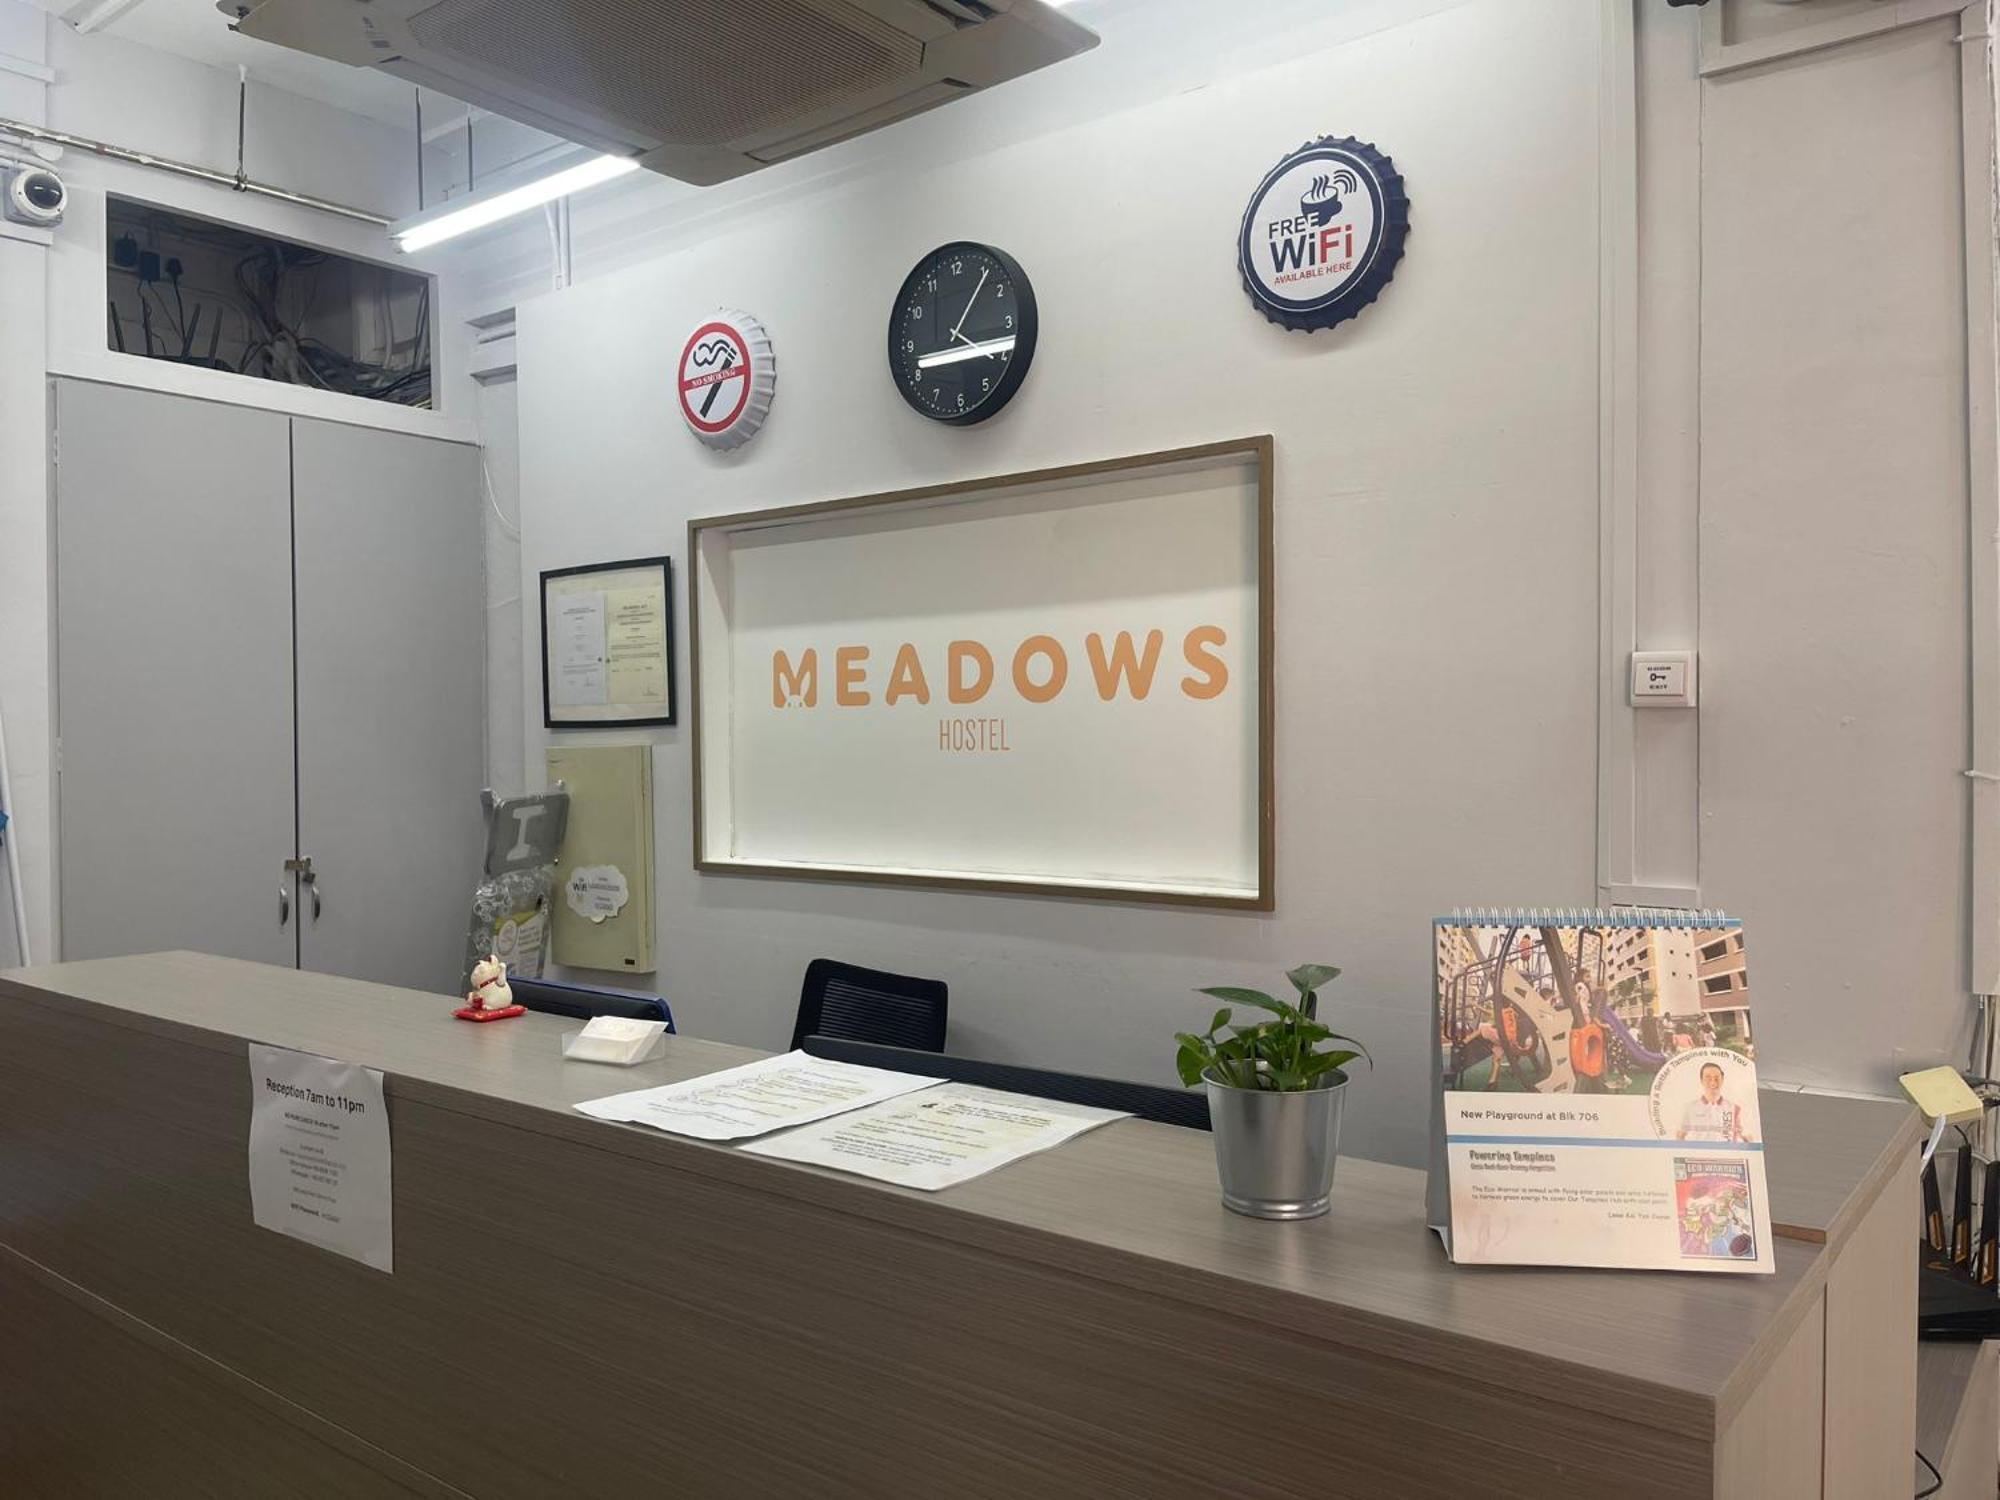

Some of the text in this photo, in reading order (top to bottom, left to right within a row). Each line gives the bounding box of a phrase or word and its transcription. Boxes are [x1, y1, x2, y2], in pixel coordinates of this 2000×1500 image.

[1269, 212, 1320, 239] FREE
[1270, 224, 1353, 273] WiFi
[951, 261, 963, 276] 12
[1274, 261, 1353, 285] AVAILABLE HERE
[928, 279, 937, 293] 11
[997, 284, 1004, 298] 2
[912, 306, 922, 320] 10
[1005, 315, 1013, 329] 3
[907, 340, 914, 353] 9
[704, 367, 736, 385] SMOKING
[915, 369, 922, 382] 8
[982, 378, 989, 391] 5
[933, 388, 940, 401] 7
[957, 393, 965, 407] 6
[772, 625, 1230, 708] MEADOWS
[939, 718, 1011, 752] HOSTEL
[1671, 1051, 1708, 1068] Tampines
[1710, 1050, 1730, 1058] with
[1732, 1054, 1750, 1067] You
[266, 1078, 365, 1114] Reception 7am to 11pm
[1461, 1110, 1599, 1121] New Playground at Blk 706
